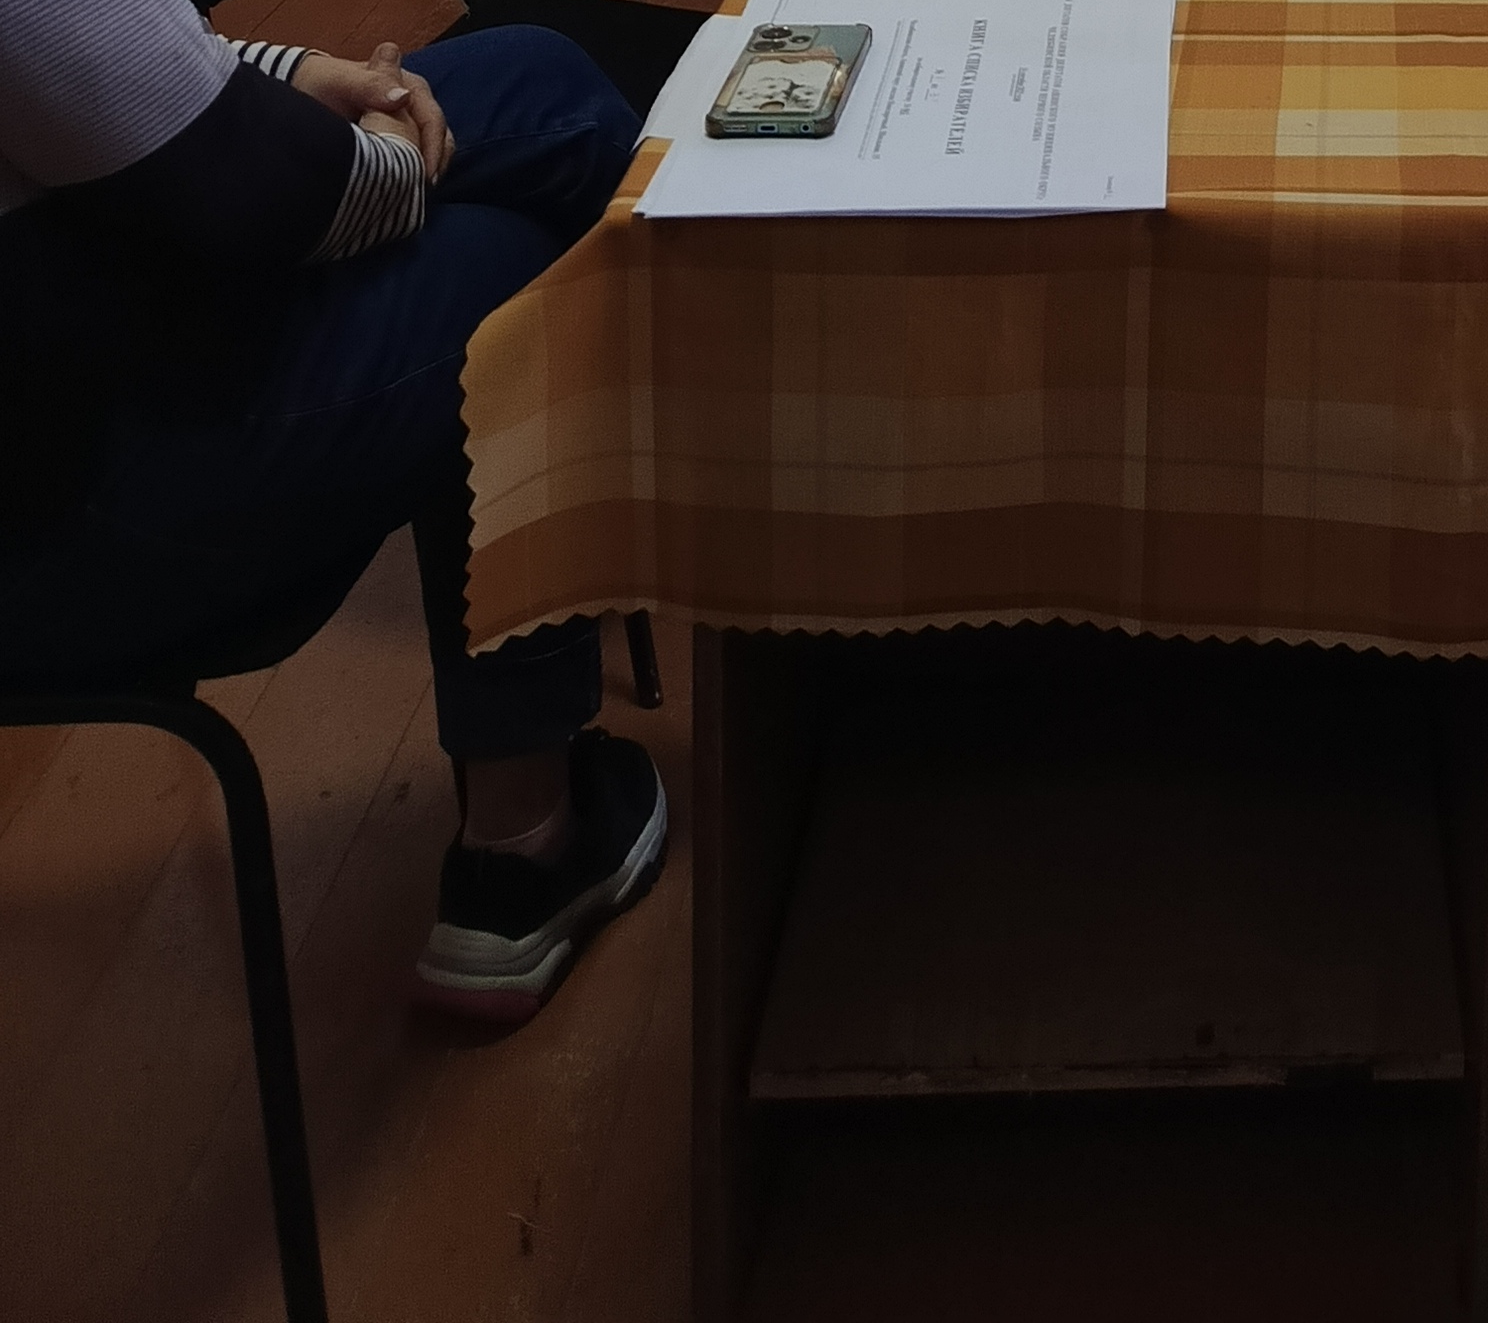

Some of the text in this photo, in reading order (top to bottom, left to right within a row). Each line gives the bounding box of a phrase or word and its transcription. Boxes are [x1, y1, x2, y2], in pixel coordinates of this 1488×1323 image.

[945, 19, 988, 155] КНИГА СПИСКА ИЗБИРАТЕЛЕЙ
